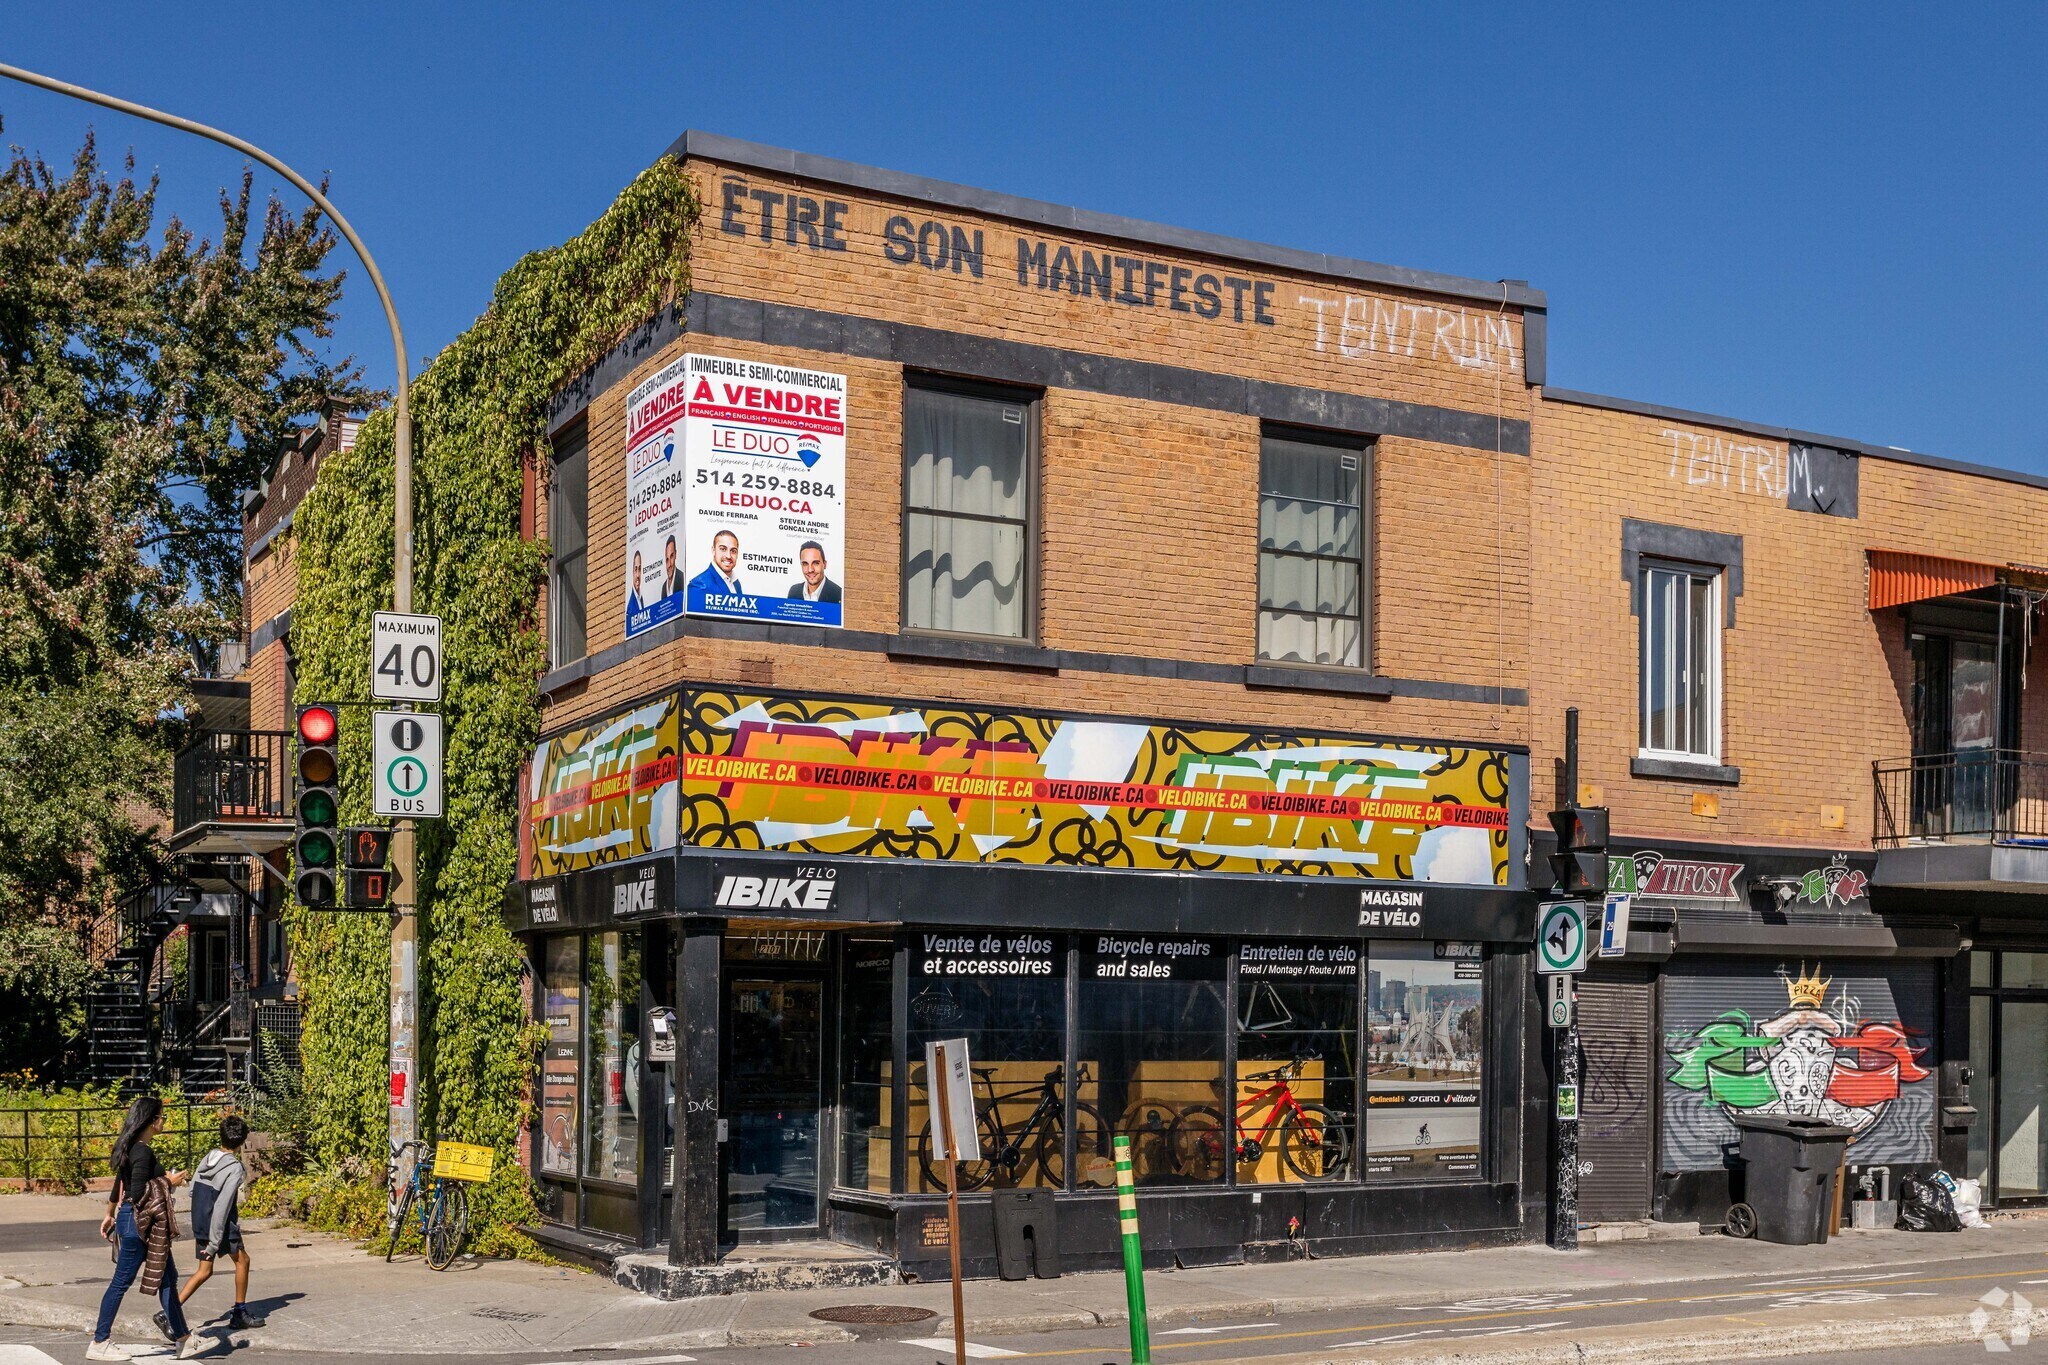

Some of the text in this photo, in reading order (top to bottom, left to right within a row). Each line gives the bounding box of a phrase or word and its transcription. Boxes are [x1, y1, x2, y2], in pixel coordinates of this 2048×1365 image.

[720, 175, 1276, 326] ÊTRE SON MANIFESTE
[691, 357, 842, 391] IMMEUBLE SEMI-COMMERCIAL
[637, 381, 684, 428] VENDRE
[693, 375, 841, 419] À VENDRE
[691, 408, 724, 417] FRANÇAIS
[732, 413, 760, 422] ENGLISH
[767, 417, 797, 426] ITALIANO
[713, 429, 789, 454] LE DUO
[643, 442, 660, 467] DUO
[629, 495, 640, 513] 514
[641, 470, 682, 504] 259-8884
[696, 468, 835, 499] 514 259-8884
[720, 491, 812, 514] LEDUO.CA
[635, 497, 672, 527] LEDUO.CA
[699, 509, 758, 520] DAVIDE FERRARA
[780, 517, 829, 529] STEVEN ANDRE
[743, 553, 793, 564] ESTIMATION
[747, 564, 788, 574] GRATUITE
[705, 594, 757, 609] RE/MAX
[378, 621, 435, 636] MAXIMUM
[377, 643, 435, 688] 40
[591, 774, 632, 800] VELOIBIKE.CA
[686, 757, 797, 782] VELOIBIKE.CA
[814, 766, 917, 791] VELOIBIKE.CA
[933, 775, 1033, 798] VELOIBIKE.CA
[1048, 784, 1144, 804] VELOIBIKE.CA
[1158, 789, 1248, 810] VELOIBIKE.CA
[1261, 795, 1347, 815] VELOIBIKE.CA
[1360, 801, 1442, 821] VELOIBIKE.CA
[391, 799, 424, 812] BUS
[640, 867, 656, 879] VELO
[796, 867, 837, 880] VELO
[1662, 864, 1726, 893] TIFOSI
[532, 885, 555, 902] MAGASIN
[614, 879, 655, 914] IBIKE
[715, 876, 837, 910] IBIKE
[1361, 891, 1423, 906] MAGASIN
[533, 908, 541, 923] DE
[1359, 908, 1420, 927] DE VÉLO
[923, 934, 1052, 954] Vente de vélos
[1097, 937, 1211, 959] Bicycle repairs
[1445, 945, 1481, 956] IBIKE
[1240, 945, 1356, 962] Entretien de vélo
[856, 959, 889, 968] NORCO
[923, 956, 1052, 975] et accessoires
[1097, 960, 1171, 978] and sales
[1240, 964, 1262, 974] Fixed
[1268, 965, 1302, 976] Montage
[1309, 965, 1332, 975] Route
[1338, 966, 1356, 975] MTB
[1794, 985, 1820, 998] PIZZA
[913, 1002, 959, 1016] OUVERT
